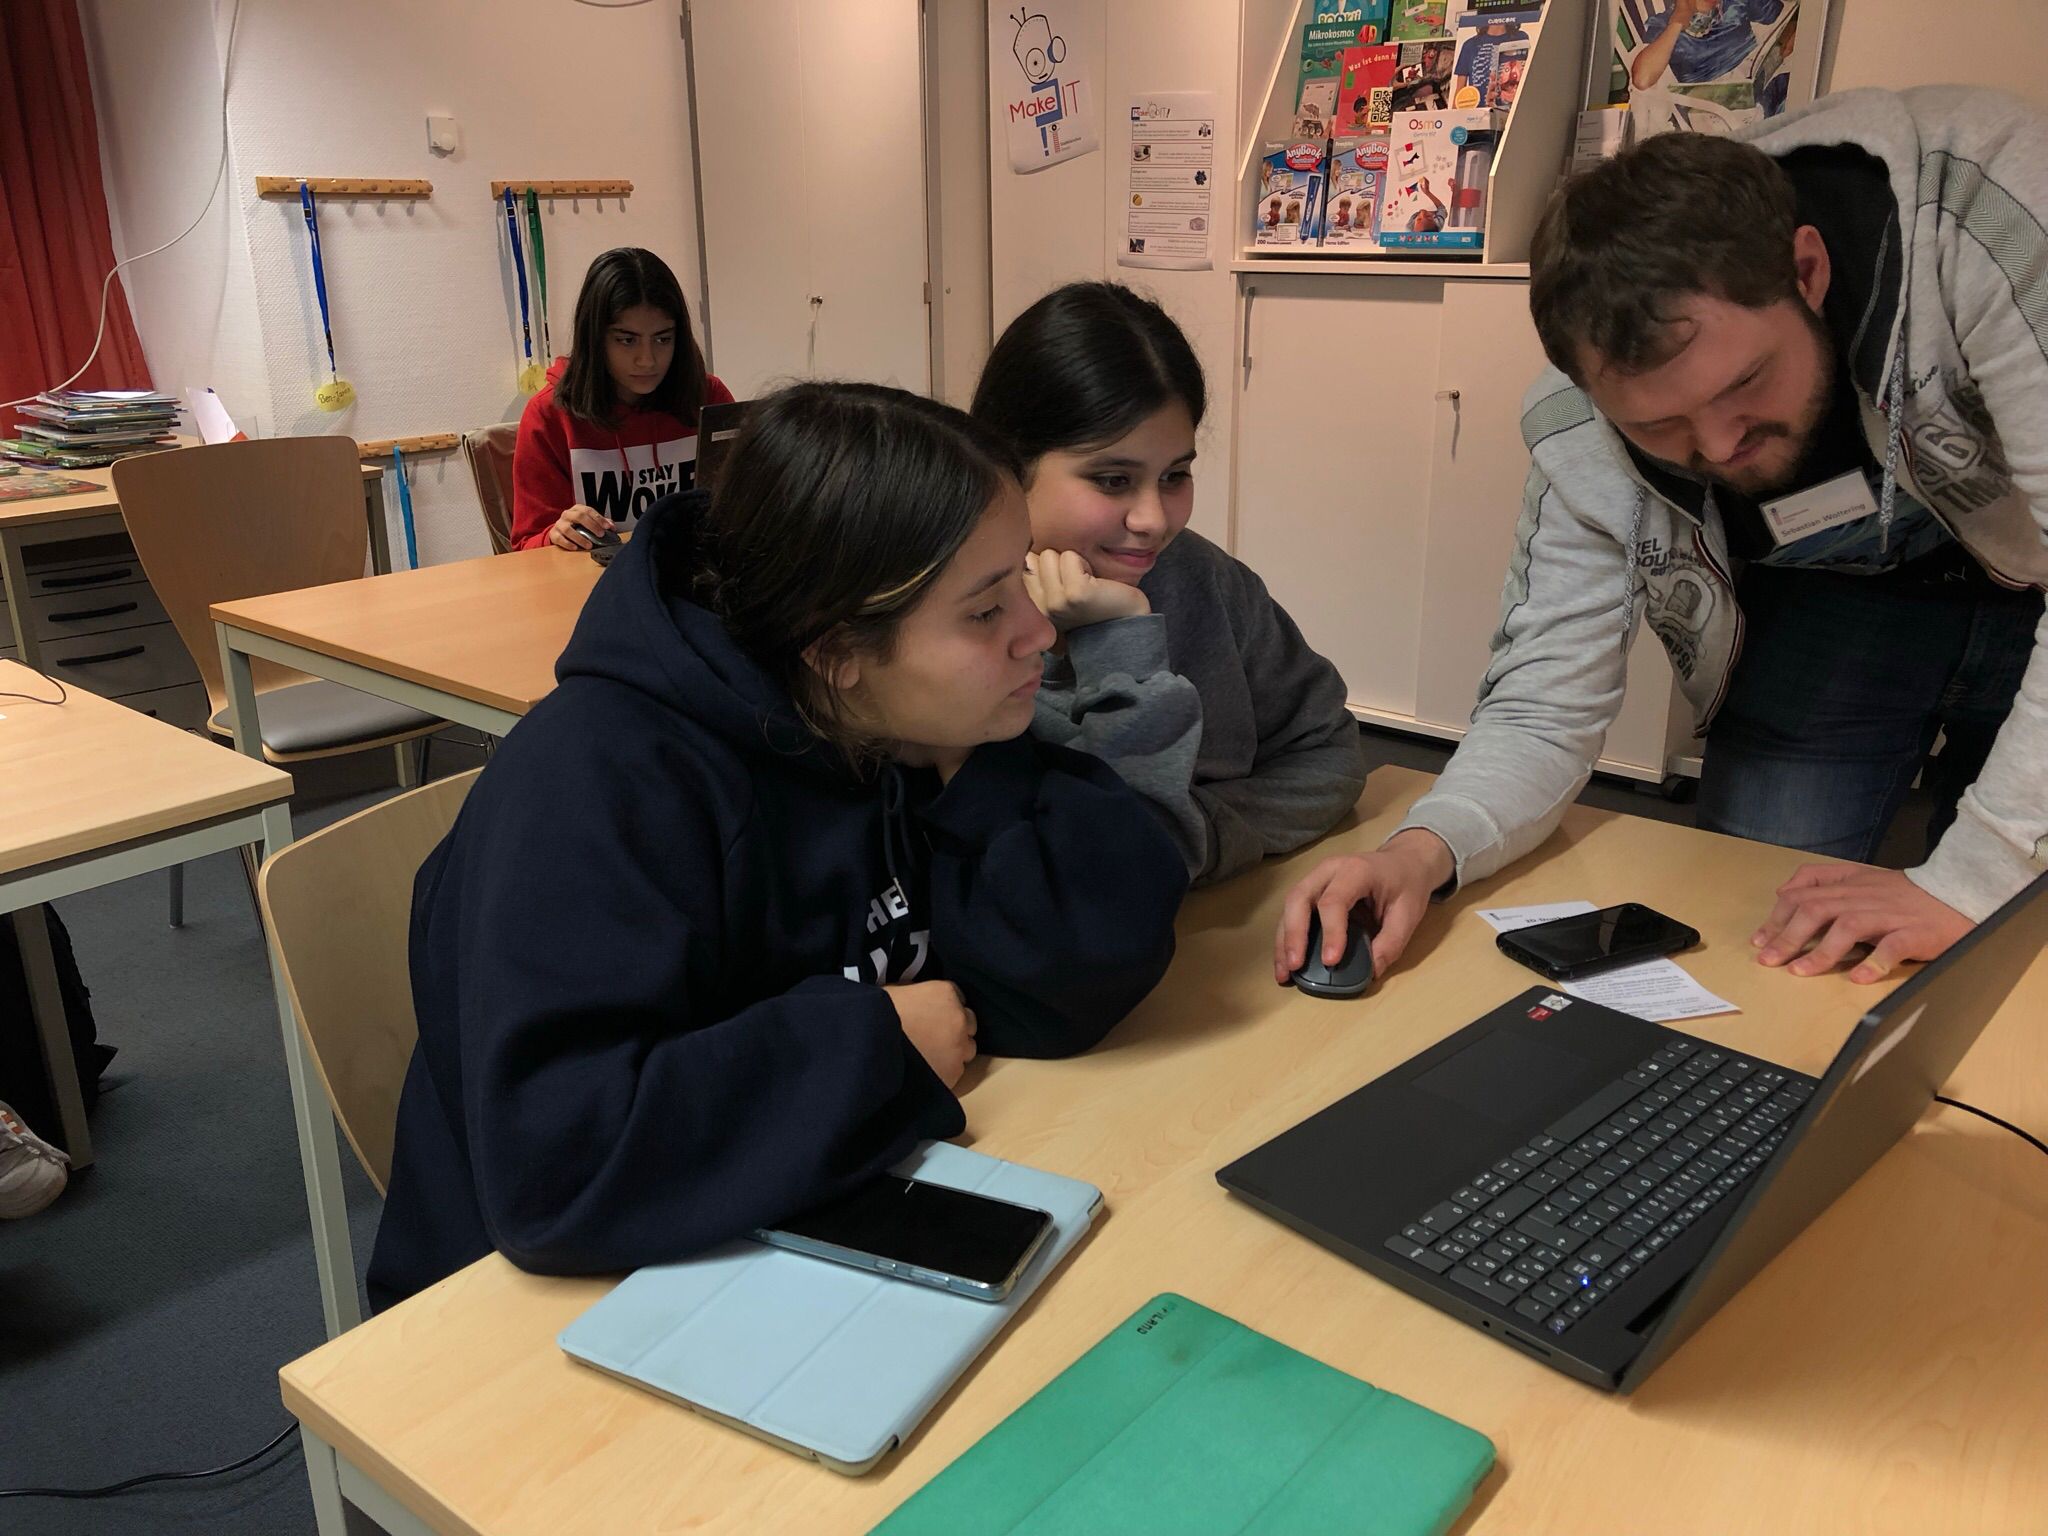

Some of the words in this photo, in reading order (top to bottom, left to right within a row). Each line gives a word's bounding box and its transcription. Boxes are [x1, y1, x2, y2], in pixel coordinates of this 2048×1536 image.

[1309, 28, 1355, 41] Mikrokosmos
[1357, 24, 1377, 44] 4D
[1348, 62, 1361, 72] Was
[1362, 57, 1373, 66] ist
[1373, 53, 1390, 62] denn
[1009, 96, 1056, 123] Make
[1062, 80, 1081, 117] IT
[1409, 119, 1442, 130] Osmo
[1286, 145, 1322, 159] AnyBook
[1355, 143, 1390, 158] AnyBoo
[638, 463, 674, 485] STAY
